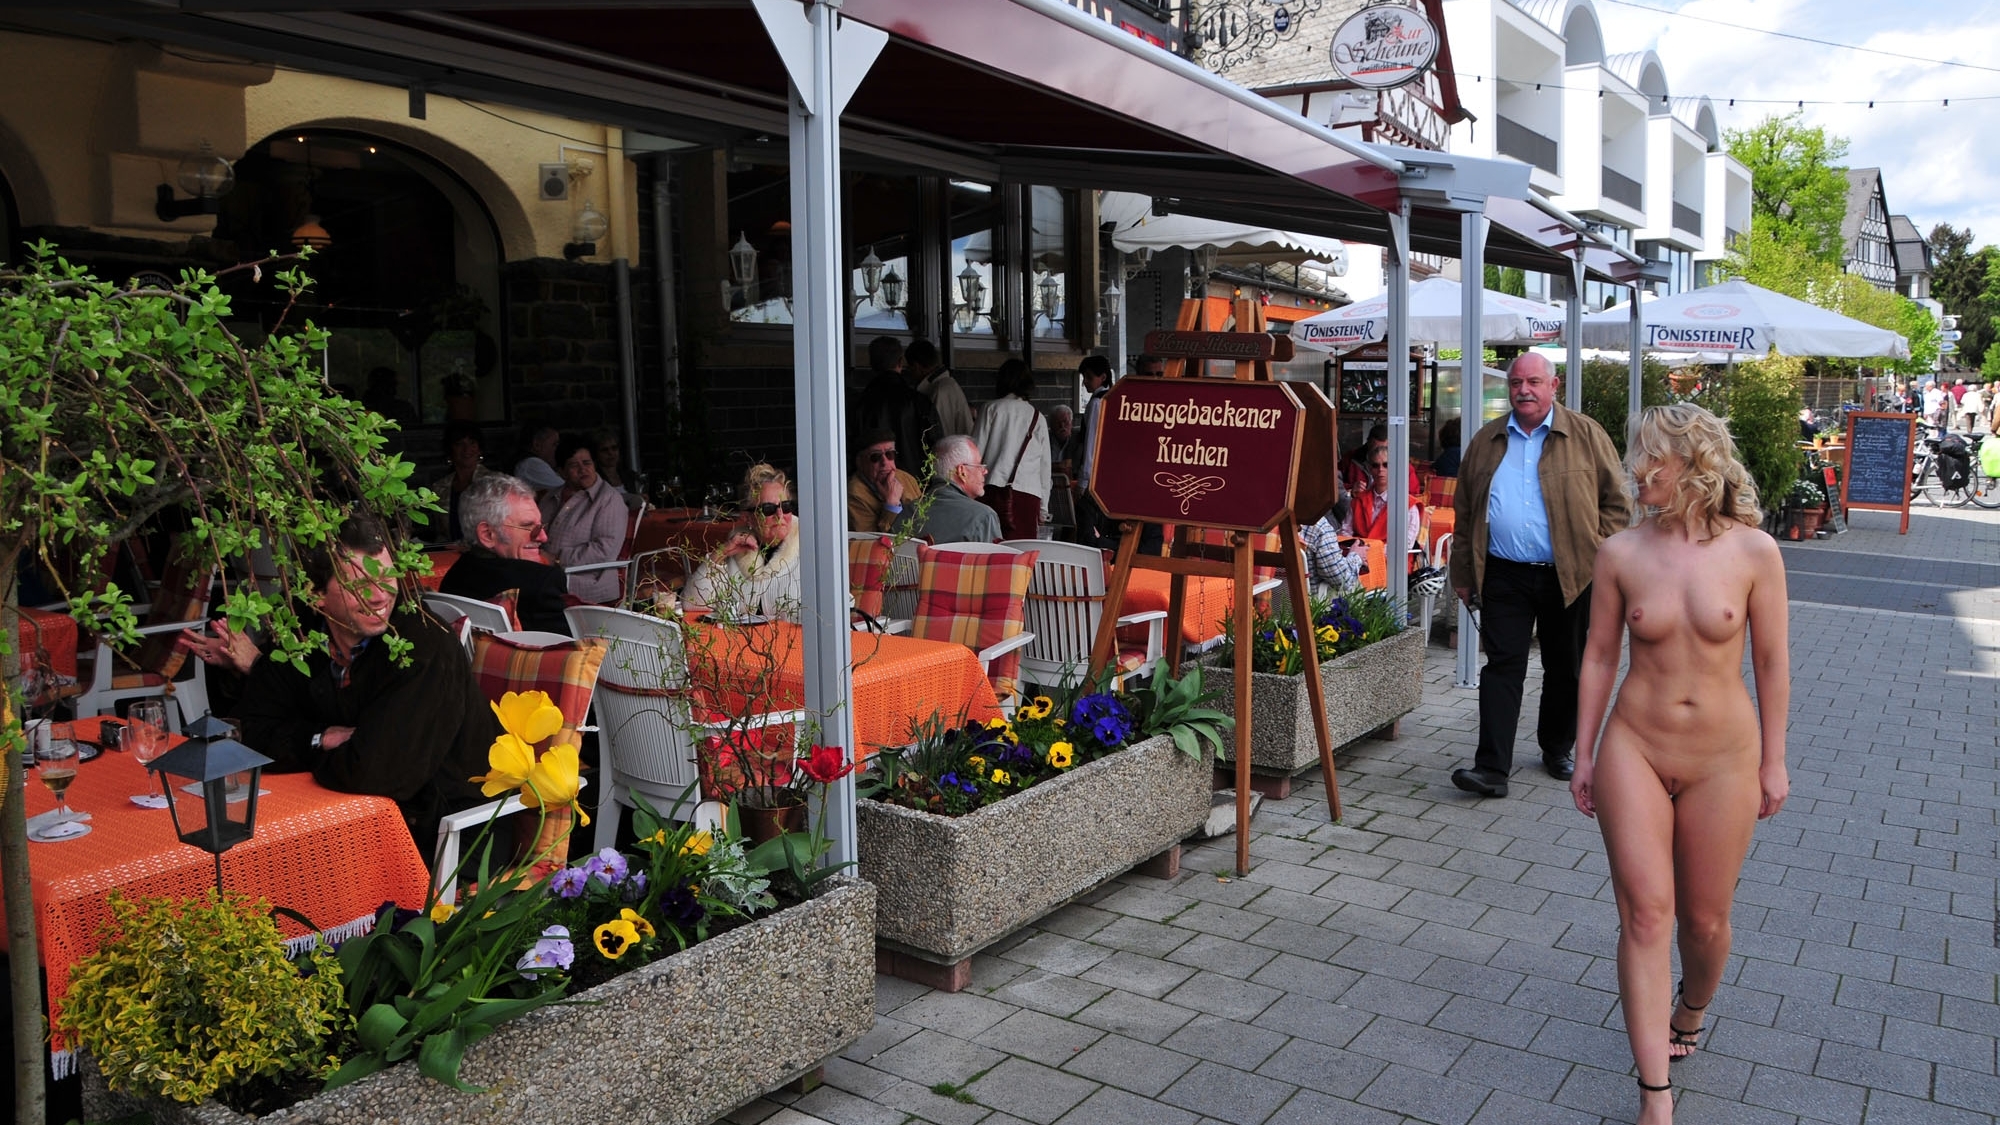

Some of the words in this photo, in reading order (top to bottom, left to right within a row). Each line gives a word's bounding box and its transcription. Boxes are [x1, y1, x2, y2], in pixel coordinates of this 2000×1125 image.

[1335, 40, 1429, 64] Scheune
[1303, 320, 1375, 341] TÖNISSTEINER
[1526, 316, 1562, 338] TÖNISST
[1646, 324, 1756, 350] TÖNISSTEINER
[1118, 395, 1282, 430] hausgebackener
[1156, 436, 1229, 468] Kuchen
